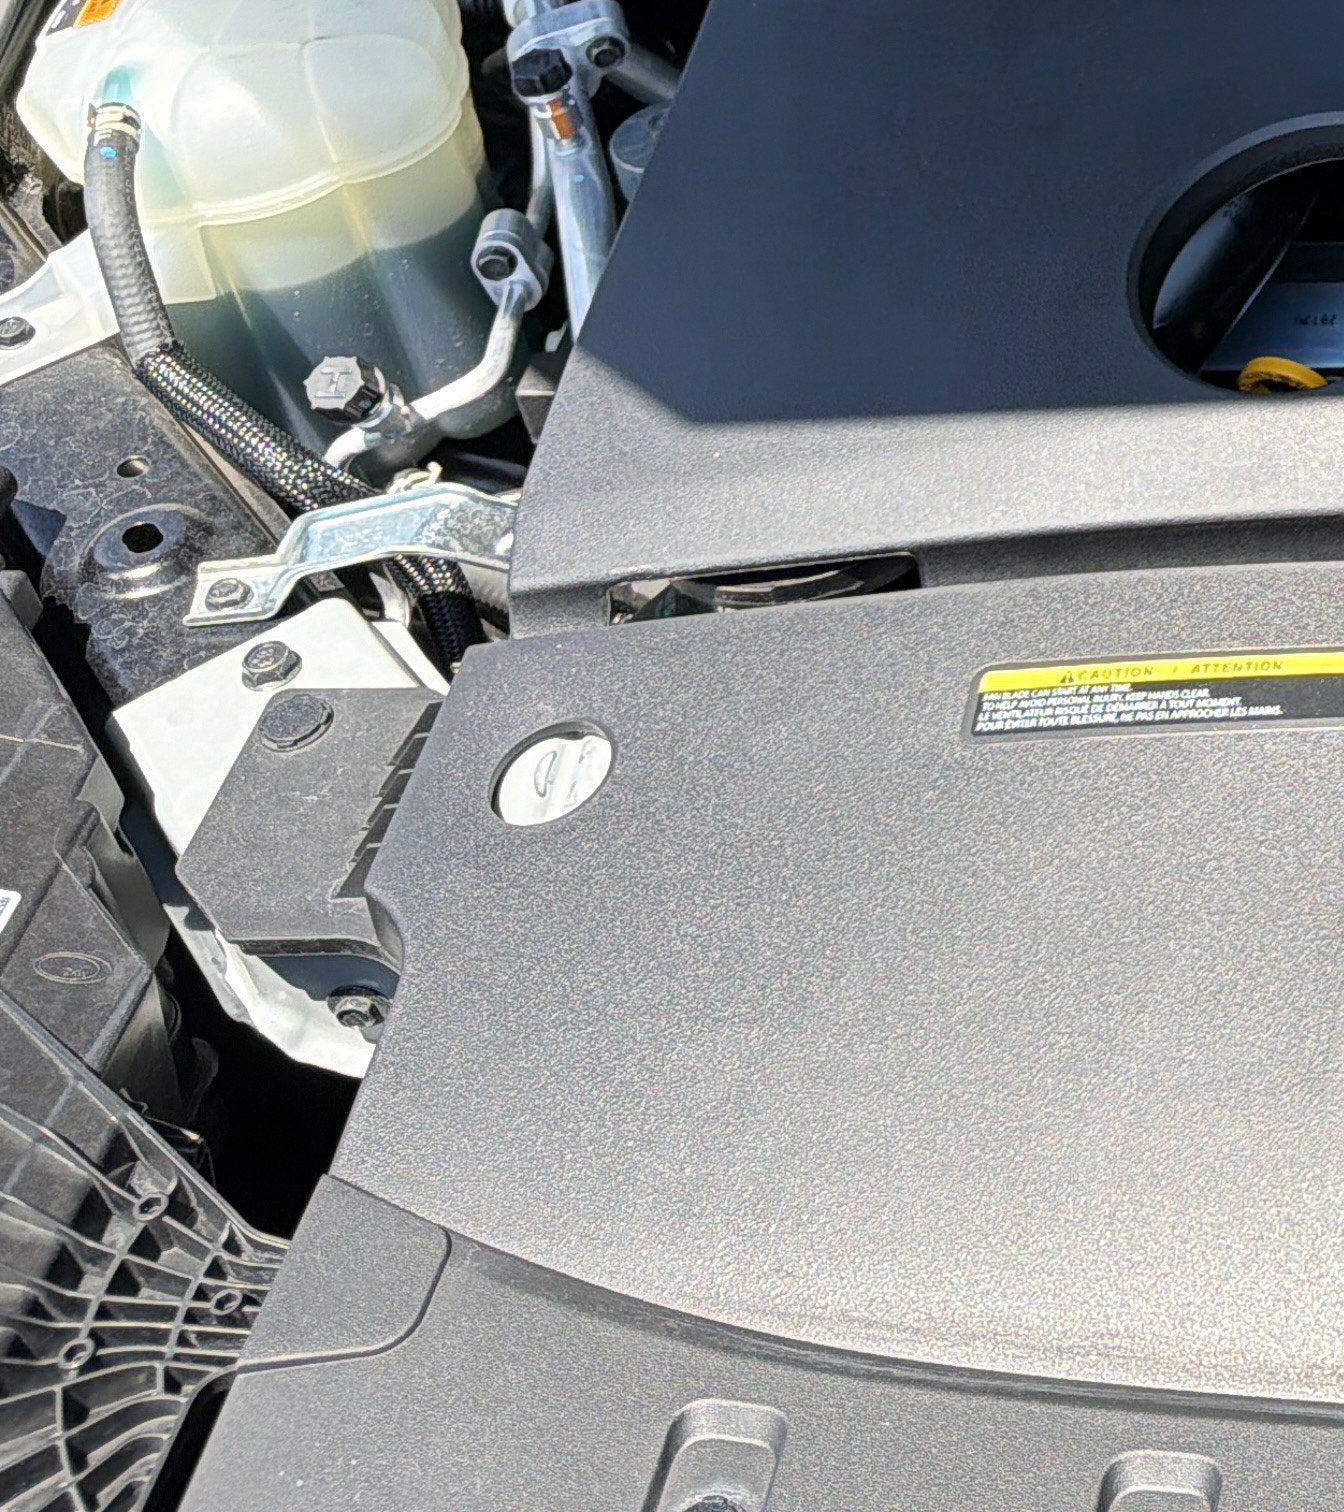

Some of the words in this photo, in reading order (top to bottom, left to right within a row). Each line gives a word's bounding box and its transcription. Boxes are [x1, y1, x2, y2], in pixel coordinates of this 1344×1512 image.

[1077, 667, 1154, 681] CAUTION
[1191, 661, 1283, 675] ATTENTION
[1031, 689, 1050, 699] CAN
[1052, 687, 1077, 698] START
[1047, 695, 1091, 707] PERSONAL
[1125, 692, 1147, 702] KEEP
[1148, 690, 1180, 700] HANDS
[977, 712, 990, 722] LE
[992, 708, 1053, 720] VENTILATEUR
[1054, 706, 1090, 718] RISQUE
[1091, 704, 1104, 715] DE
[1169, 698, 1194, 709] TOUT
[974, 720, 1004, 732] POUR
[1038, 716, 1069, 728] TOUTE
[1136, 709, 1154, 721] PAS
[1155, 709, 1172, 720] EN
[1172, 707, 1230, 720] APPROCHER
[1230, 705, 1248, 717] LES
